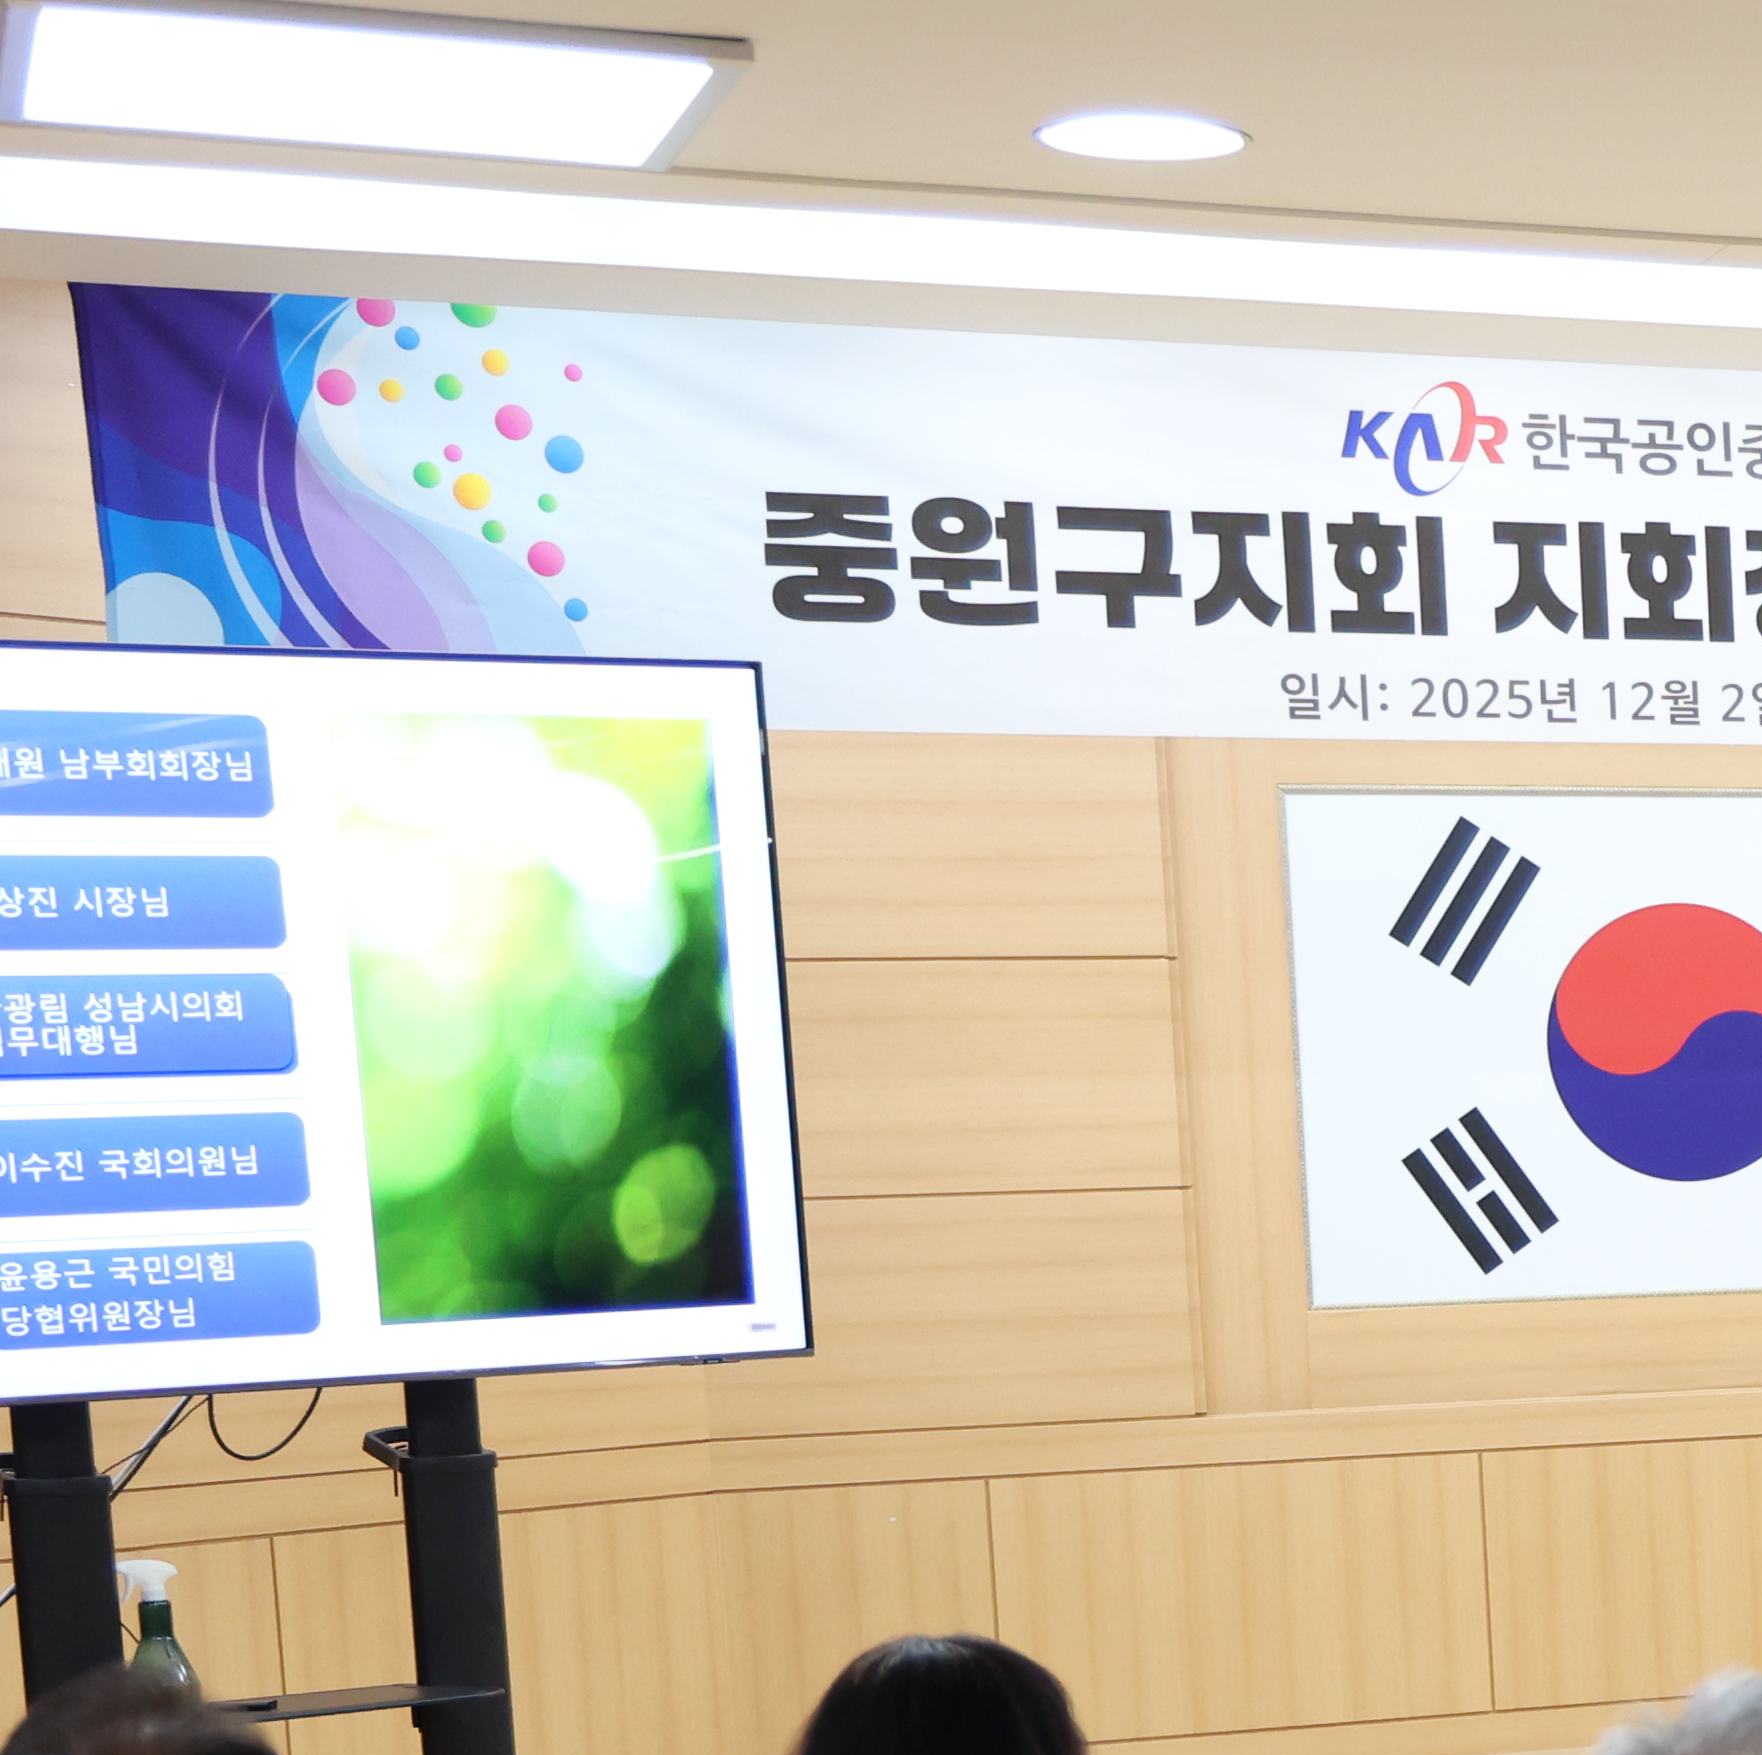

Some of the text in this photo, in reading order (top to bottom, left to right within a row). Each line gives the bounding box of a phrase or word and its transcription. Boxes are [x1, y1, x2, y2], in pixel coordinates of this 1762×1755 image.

[764, 491, 1448, 636] 중원구지회
[1281, 674, 1388, 721] 일시:
[1412, 678, 1577, 723] 2025년
[1603, 680, 1700, 725] 12월
[60, 748, 253, 781] 남부회회장님
[74, 887, 169, 917] 시장님
[84, 991, 243, 1023] 성남시의회
[0, 1026, 137, 1057] 무대행님
[99, 1145, 258, 1179] 국회의원님
[0, 1251, 235, 1291] 윤용근 국민의힘
[1, 1298, 195, 1336] 당협위원장님
